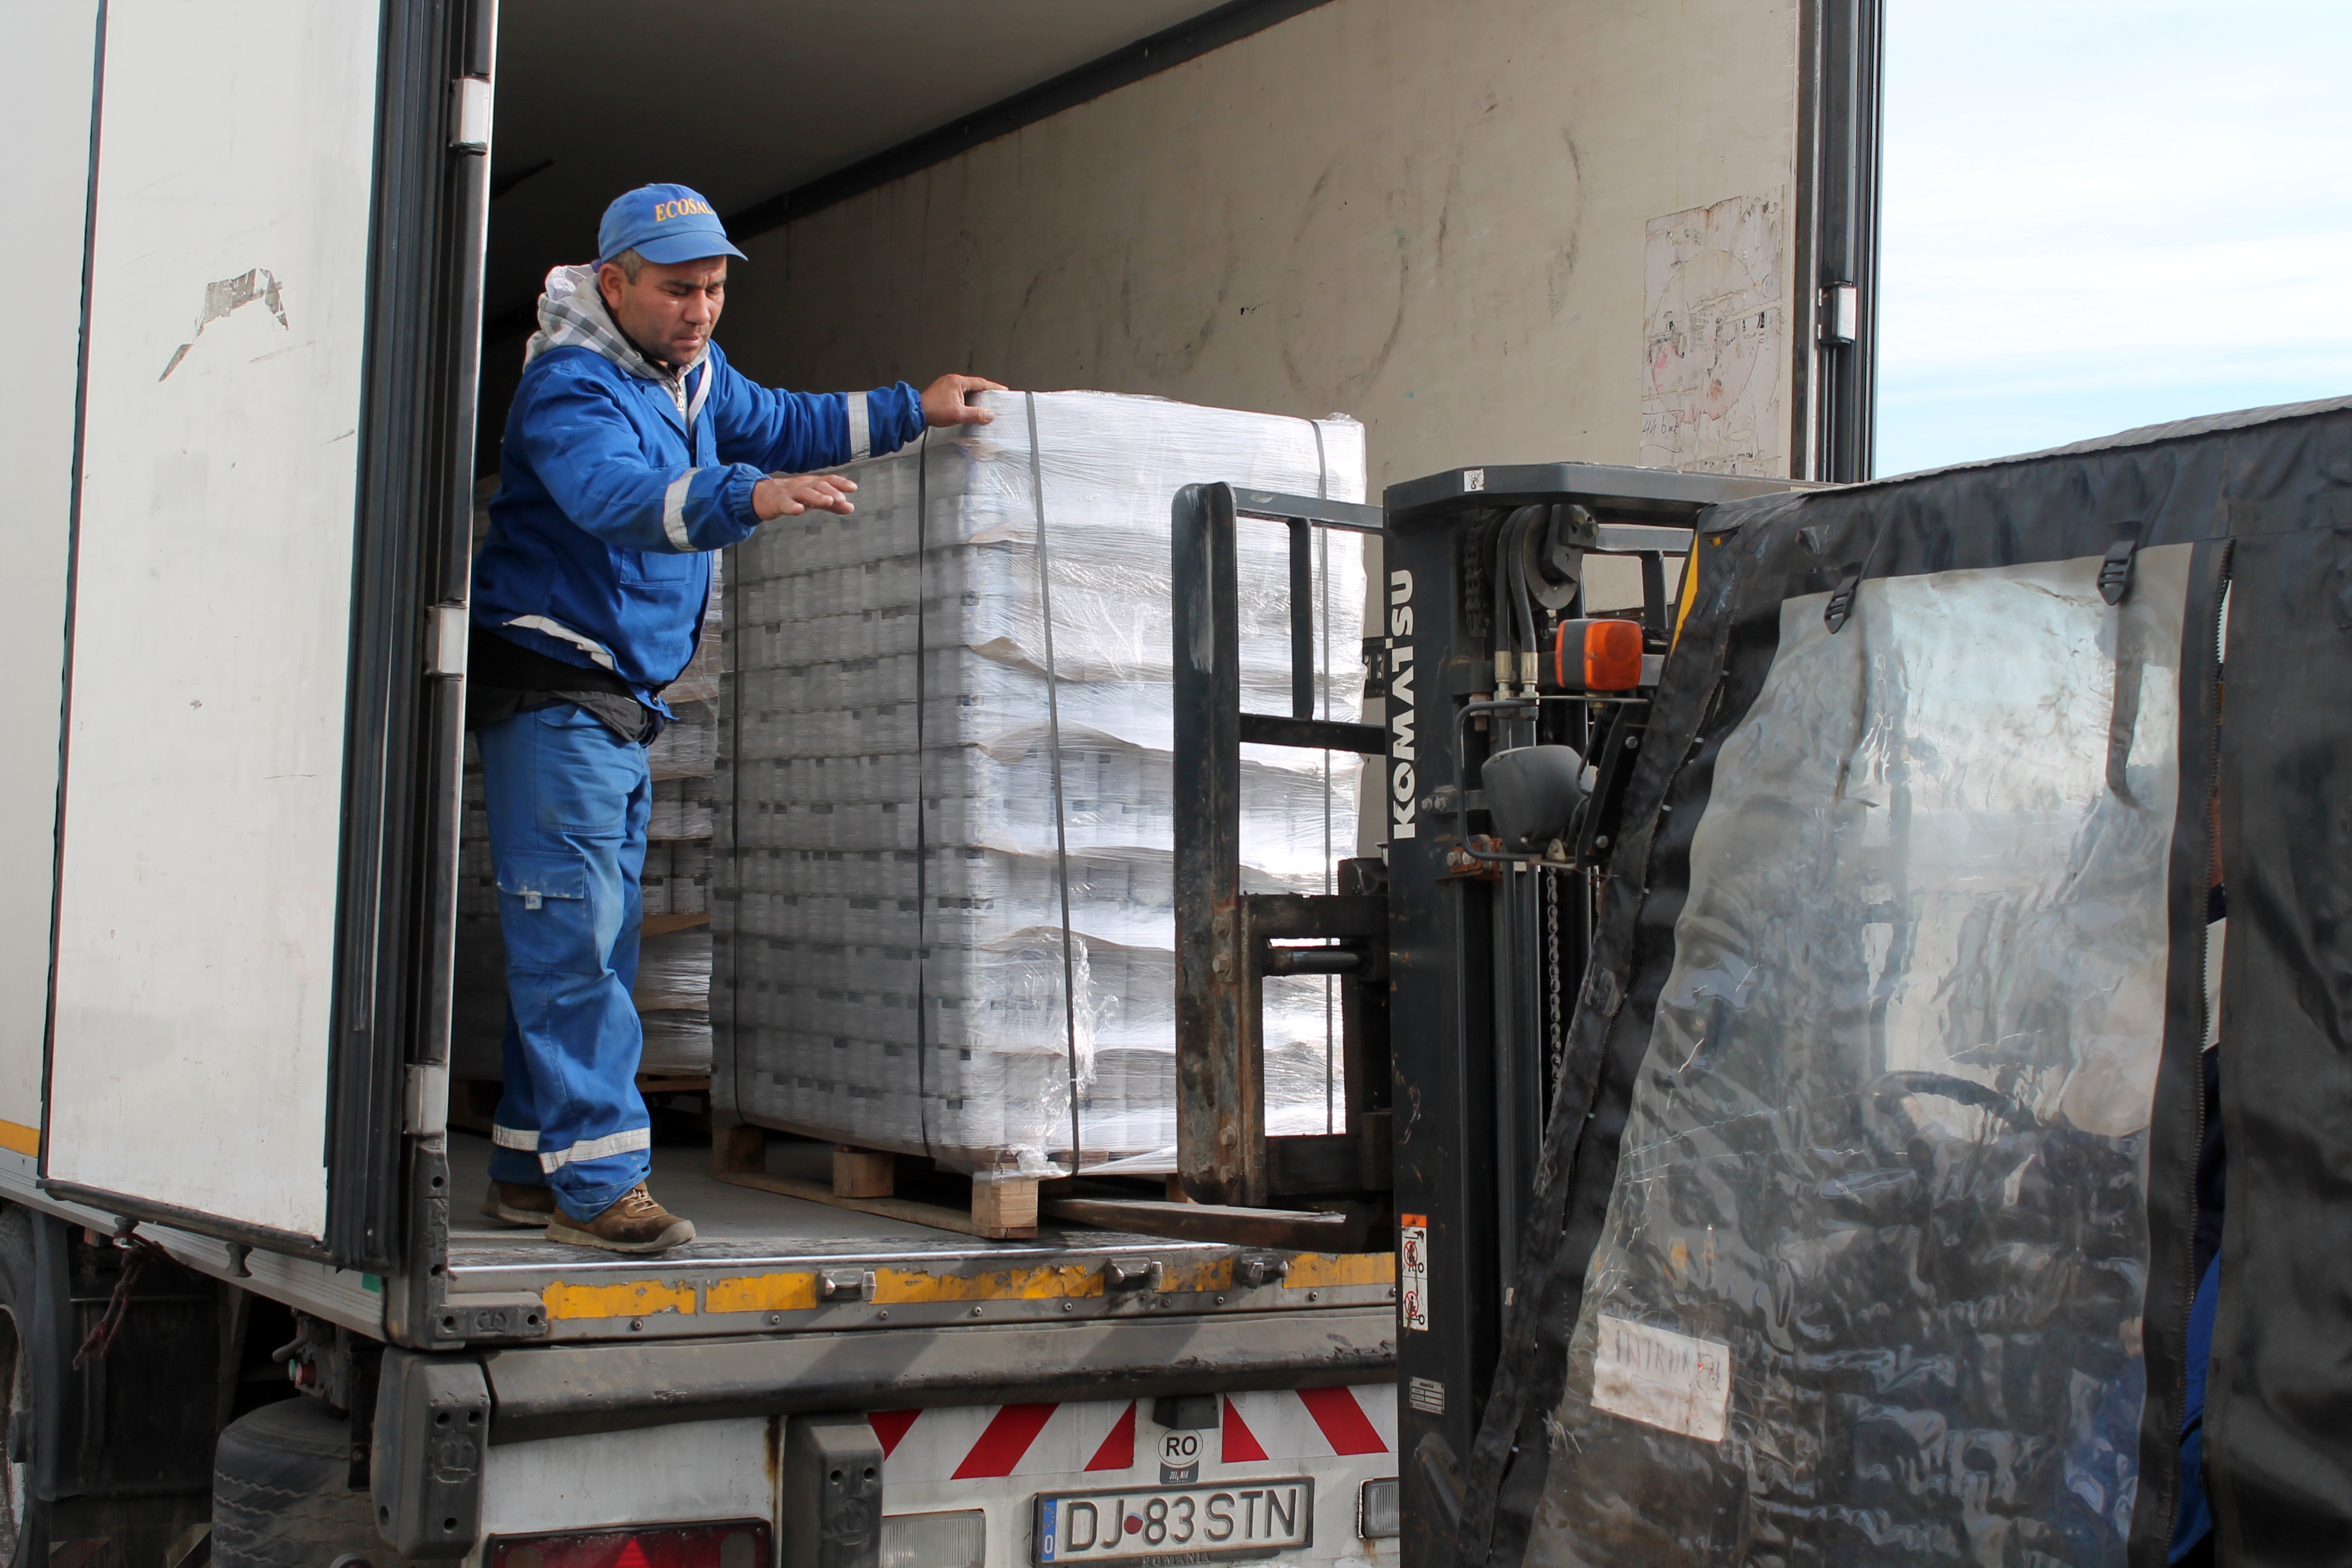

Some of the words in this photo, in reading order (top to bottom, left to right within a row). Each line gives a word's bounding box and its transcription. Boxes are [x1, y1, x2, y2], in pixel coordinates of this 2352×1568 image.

[1385, 569, 1416, 839] KOMATSU
[1166, 1435, 1197, 1456] RO
[1067, 1499, 1124, 1553] DJ
[1142, 1551, 1211, 1567] ROMANIA
